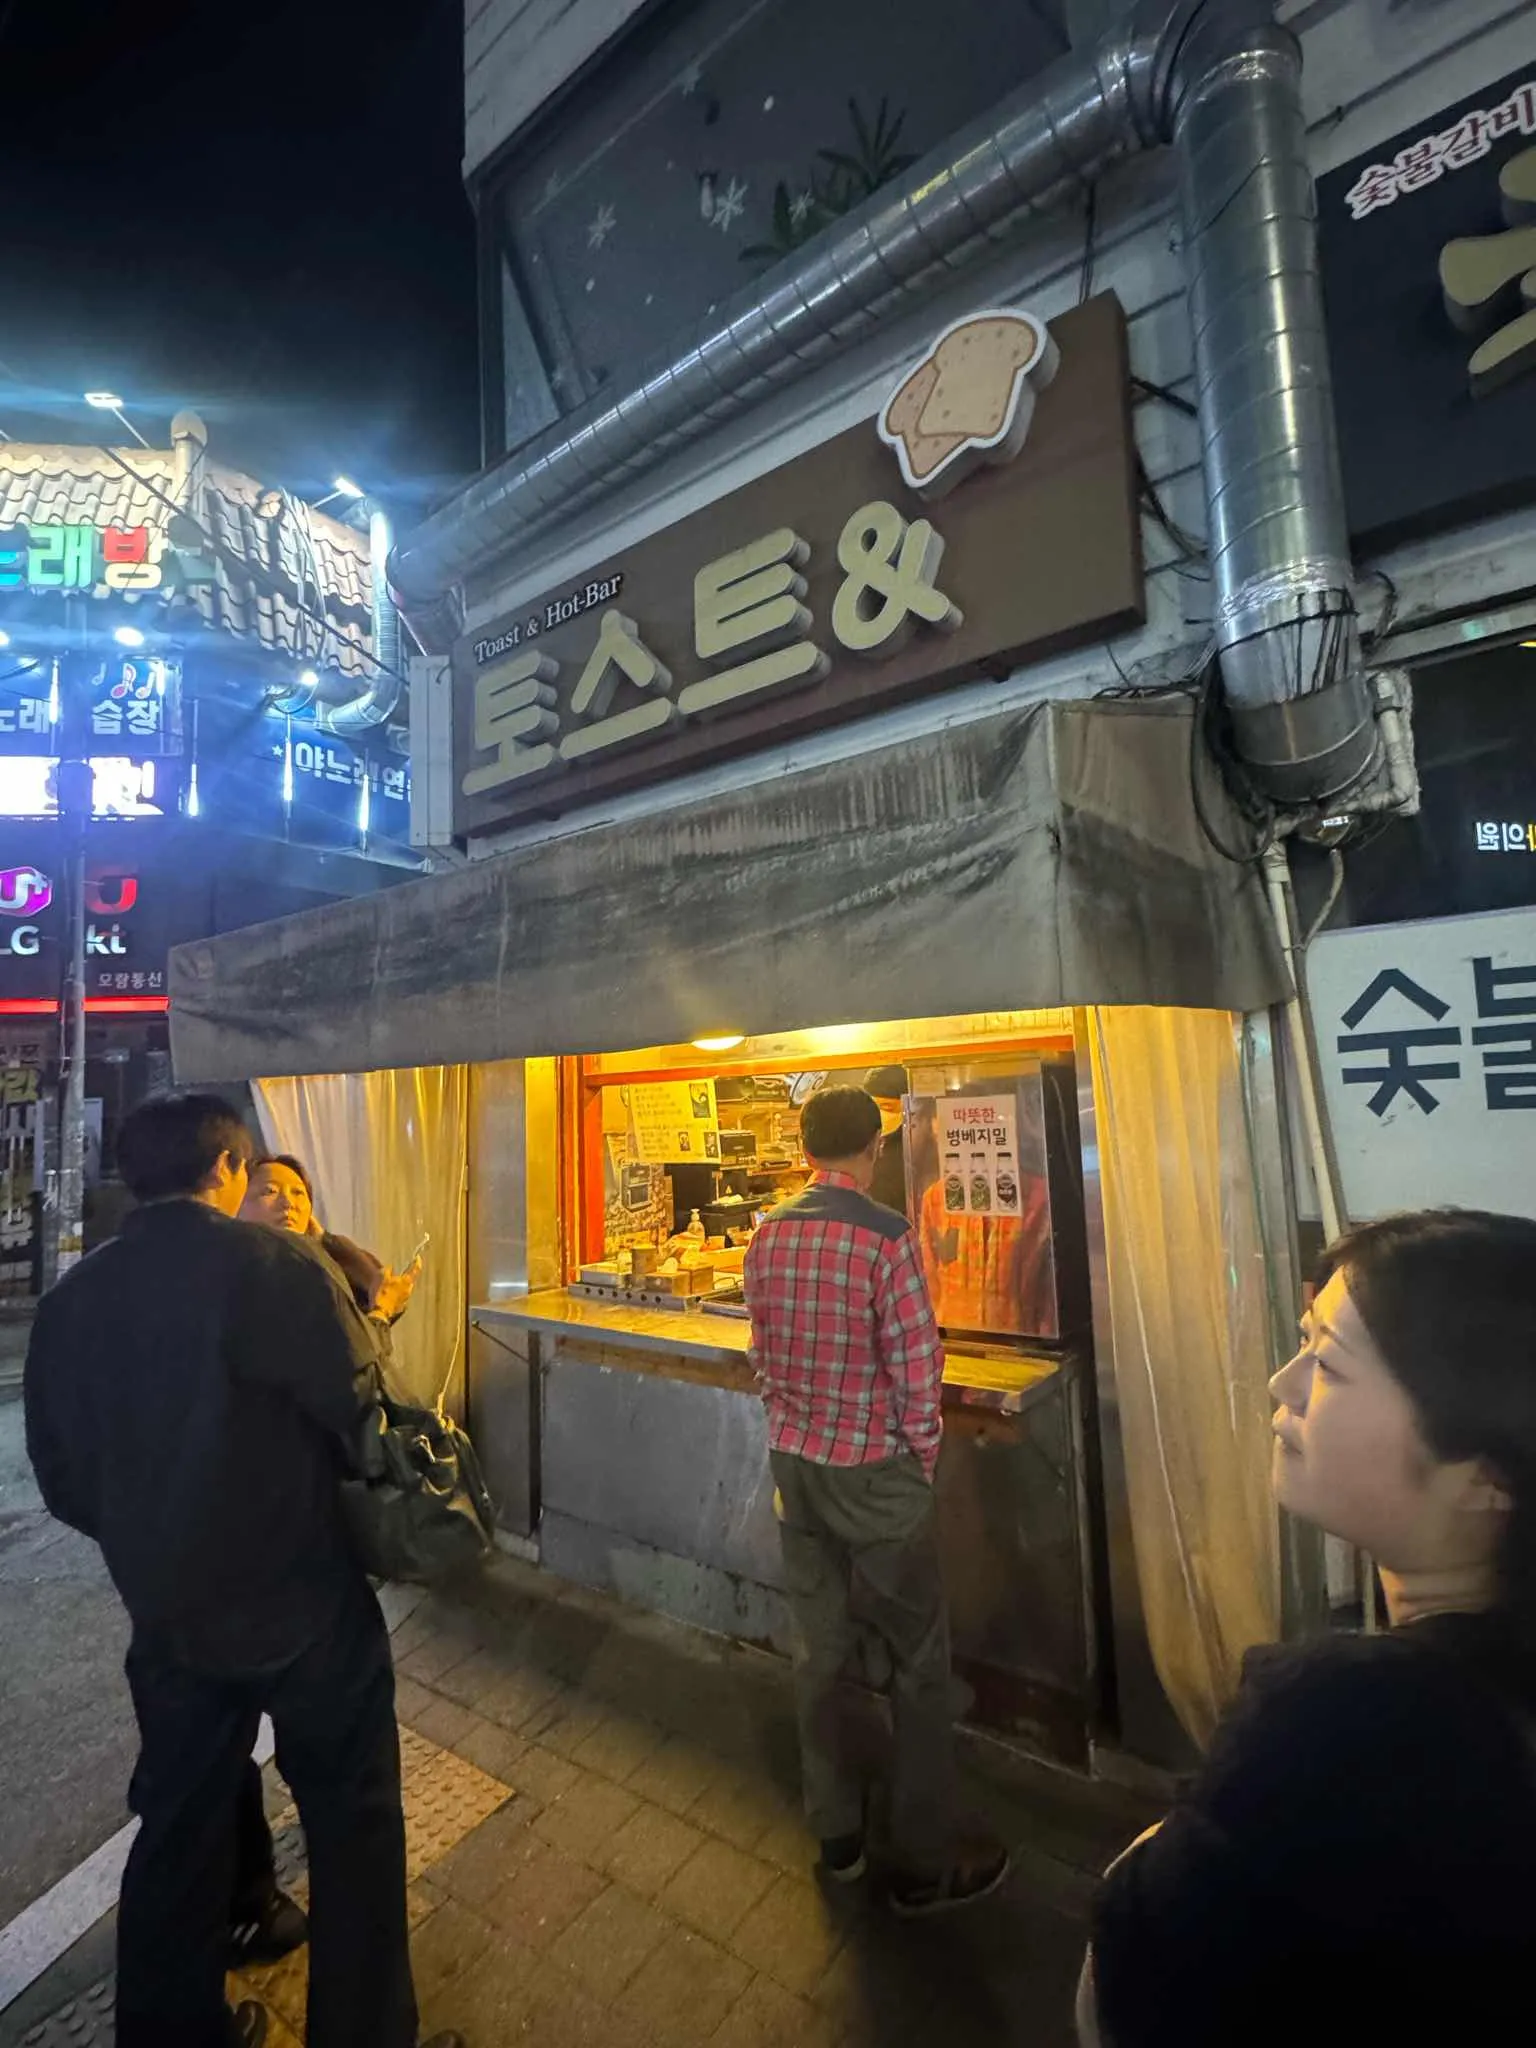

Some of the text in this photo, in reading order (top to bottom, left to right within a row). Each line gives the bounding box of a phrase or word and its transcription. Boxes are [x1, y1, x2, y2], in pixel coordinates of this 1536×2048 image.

[1346, 84, 1536, 217] 숯불갈비
[475, 575, 621, 663] Toast & Hot-Bar
[946, 1127, 1007, 1147] 병베지밀
[953, 1108, 996, 1124] 따뜻한
